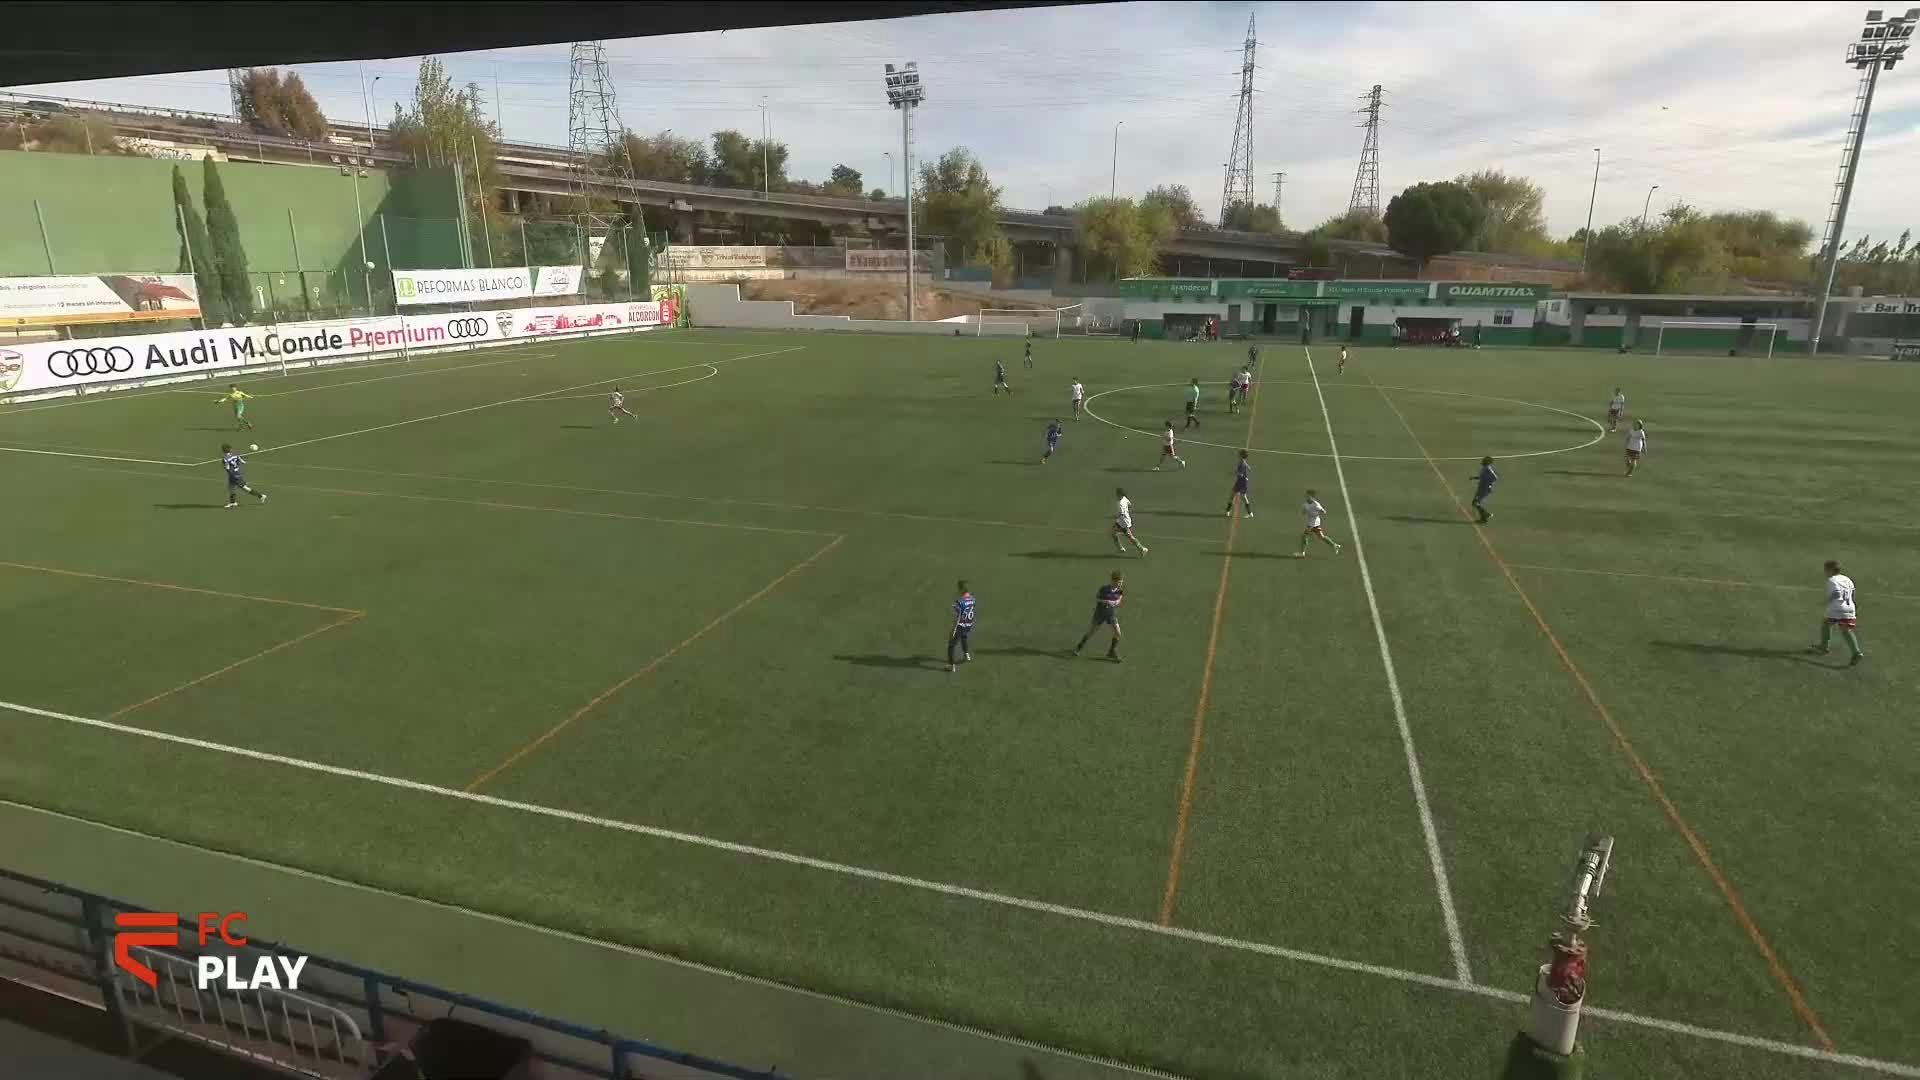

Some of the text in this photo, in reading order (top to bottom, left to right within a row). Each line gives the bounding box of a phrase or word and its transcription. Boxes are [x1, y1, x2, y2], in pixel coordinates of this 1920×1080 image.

[417, 279, 476, 294] REFORMAS
[479, 276, 523, 292] BLANCO
[1449, 286, 1536, 297] QUAMTRAX
[1875, 303, 1899, 313] Bar
[145, 338, 218, 369] Audi
[350, 323, 445, 347] Premium
